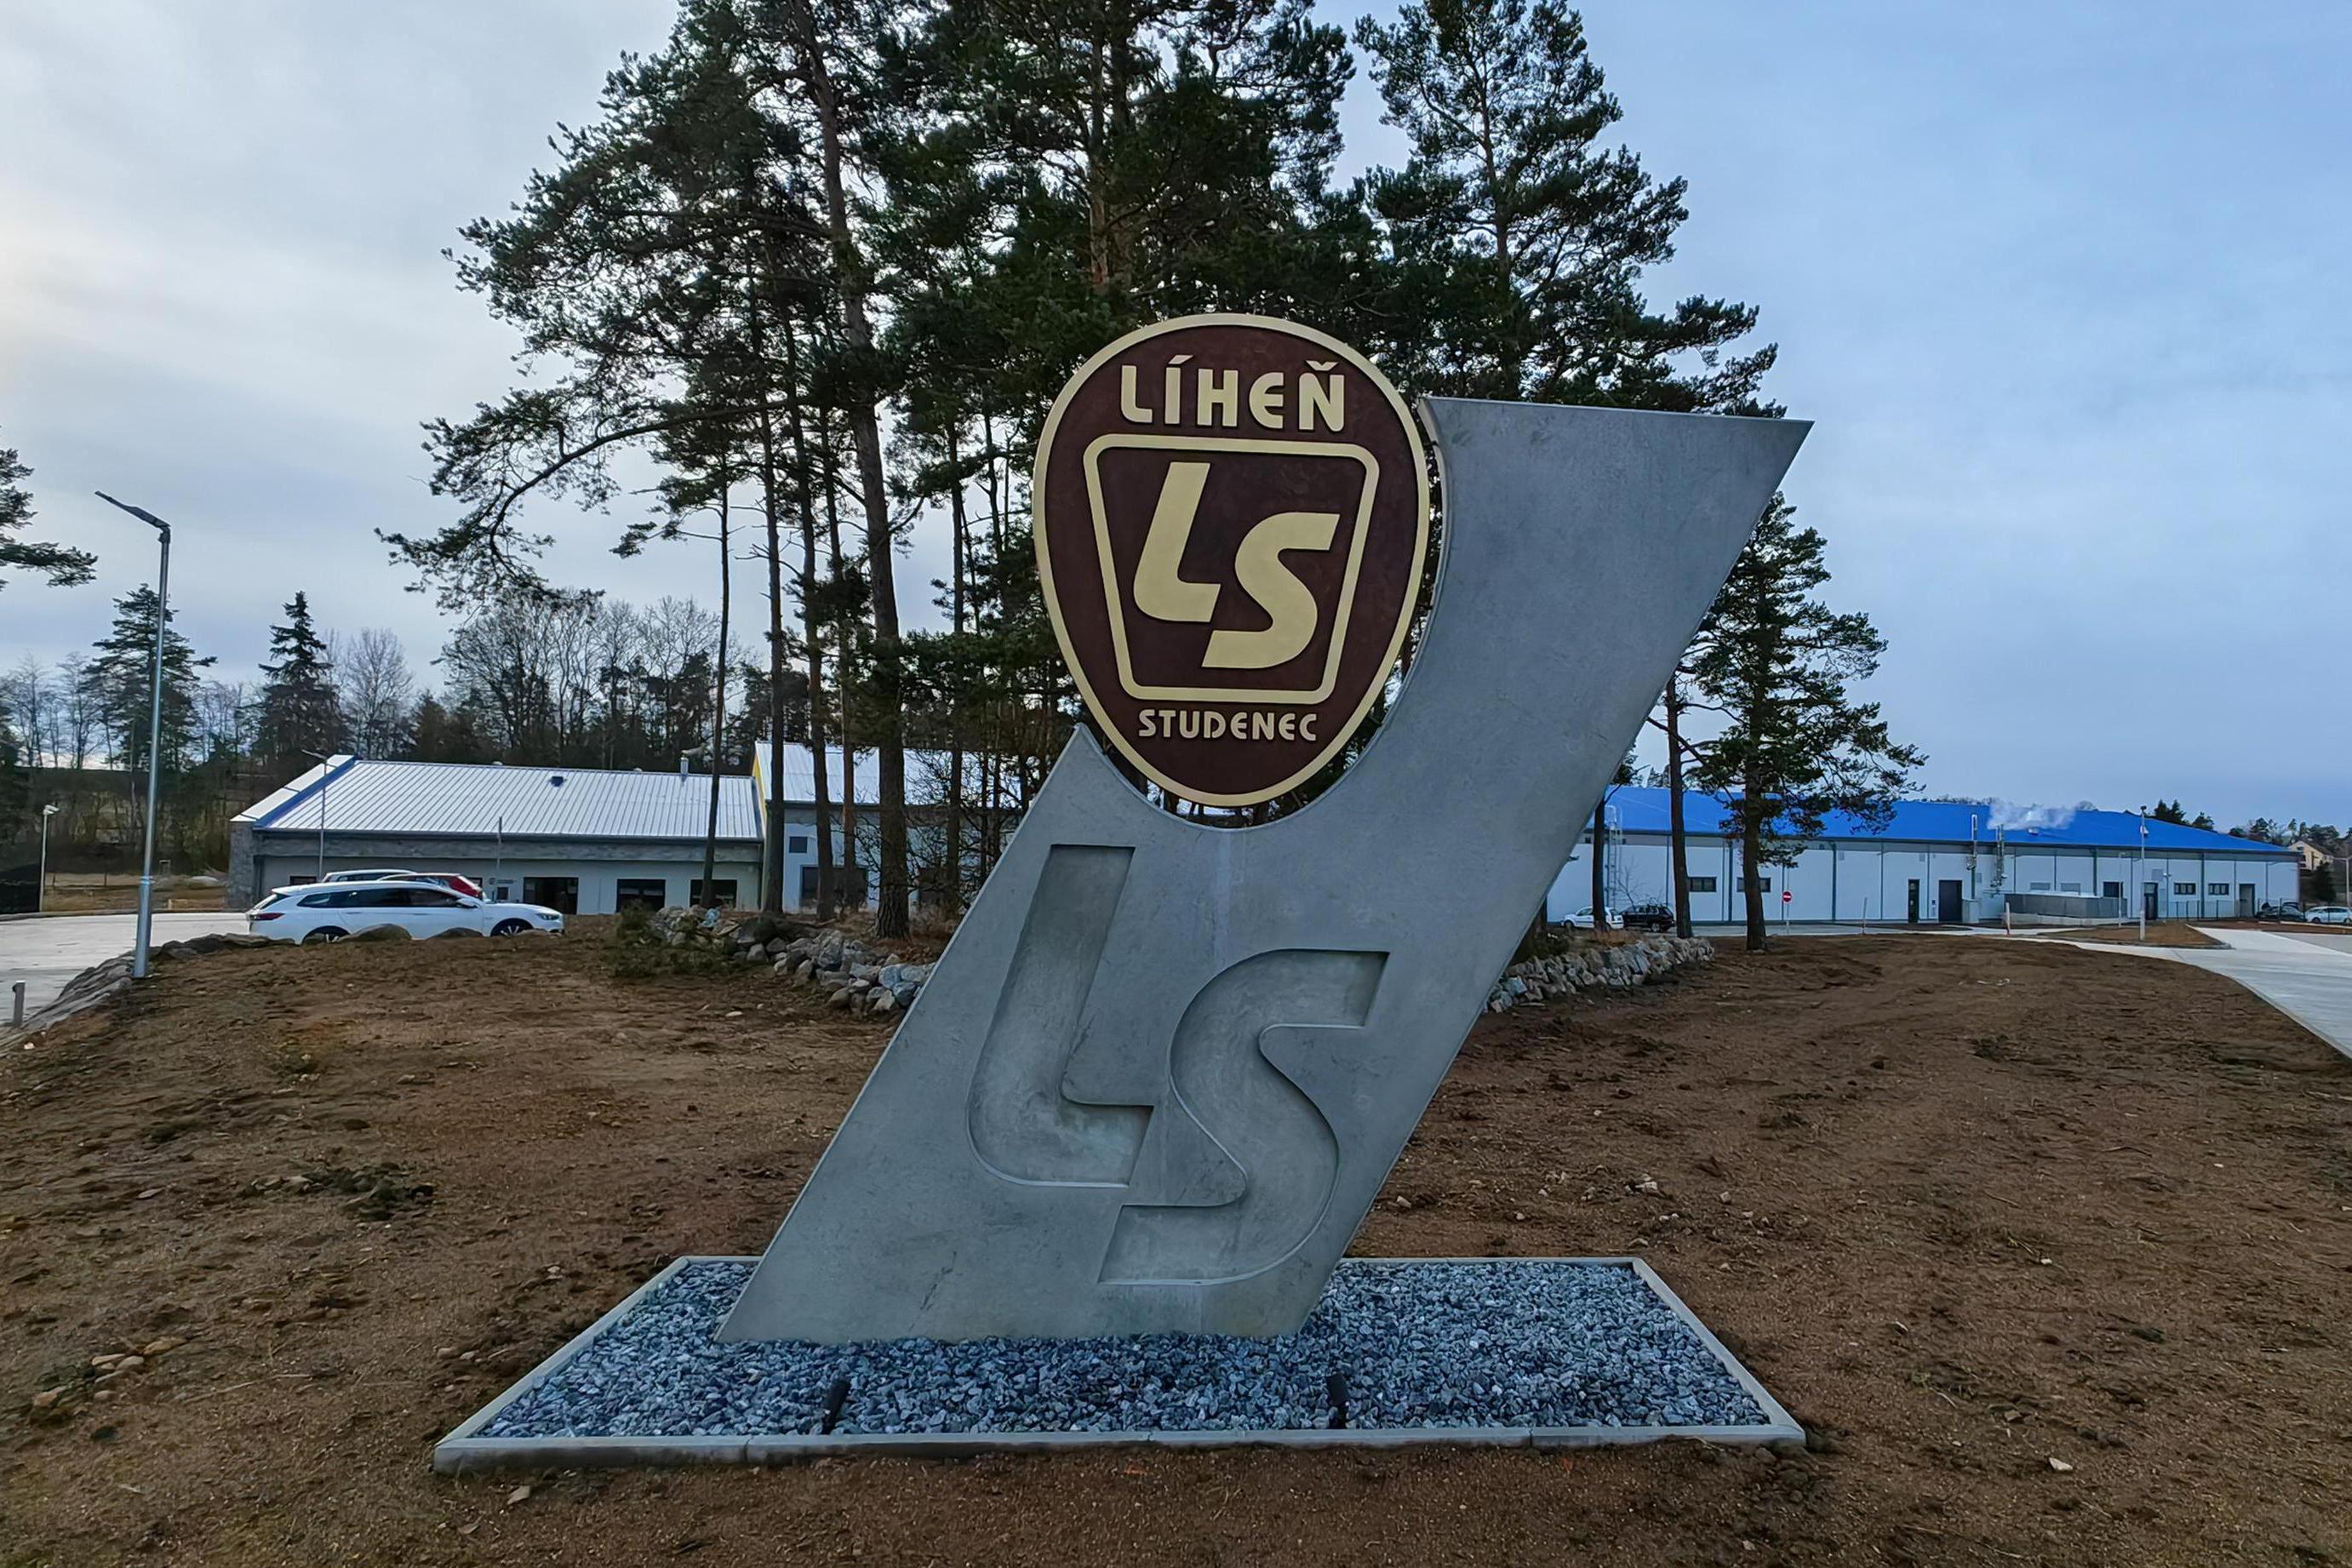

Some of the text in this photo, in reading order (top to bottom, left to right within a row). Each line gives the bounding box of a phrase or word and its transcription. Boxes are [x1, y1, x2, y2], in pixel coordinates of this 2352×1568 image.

[1133, 461, 1341, 668] LS
[1138, 709, 1318, 741] STUDENEC
[966, 843, 1390, 1285] LS
